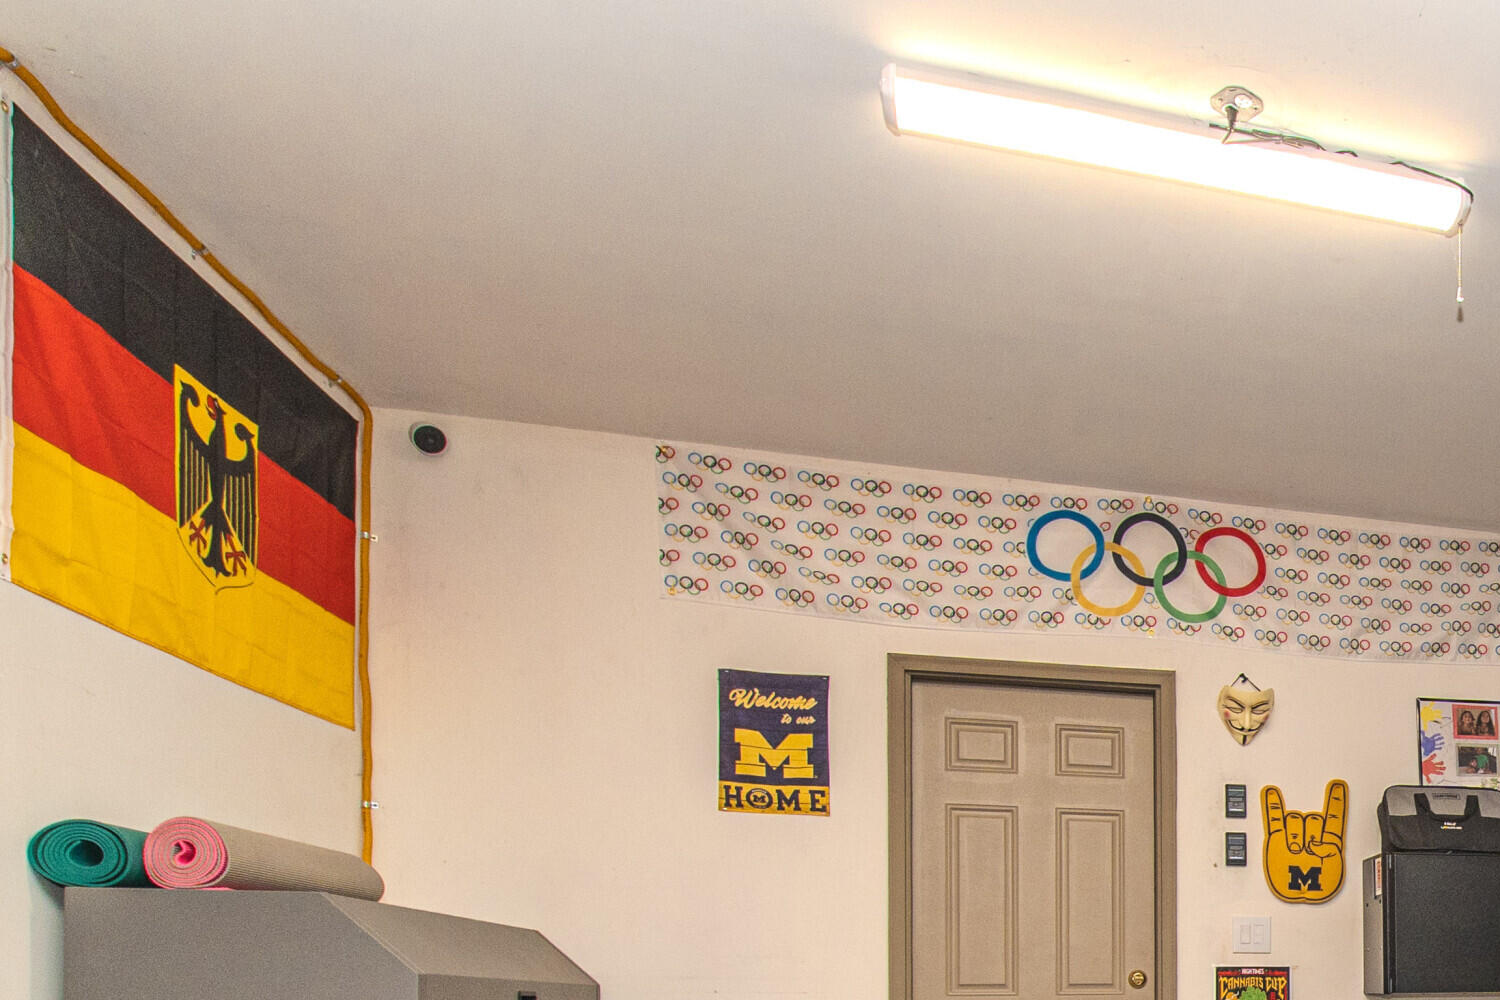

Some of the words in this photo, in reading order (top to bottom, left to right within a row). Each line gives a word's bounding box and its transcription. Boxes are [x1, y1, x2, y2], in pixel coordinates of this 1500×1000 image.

[729, 688, 818, 709] Welcome
[781, 713, 792, 724] to
[734, 728, 814, 778] M
[723, 785, 827, 812] HOME
[1288, 866, 1323, 891] M
[1219, 977, 1264, 999] CANNABIS
[1266, 977, 1287, 1000] CUP
